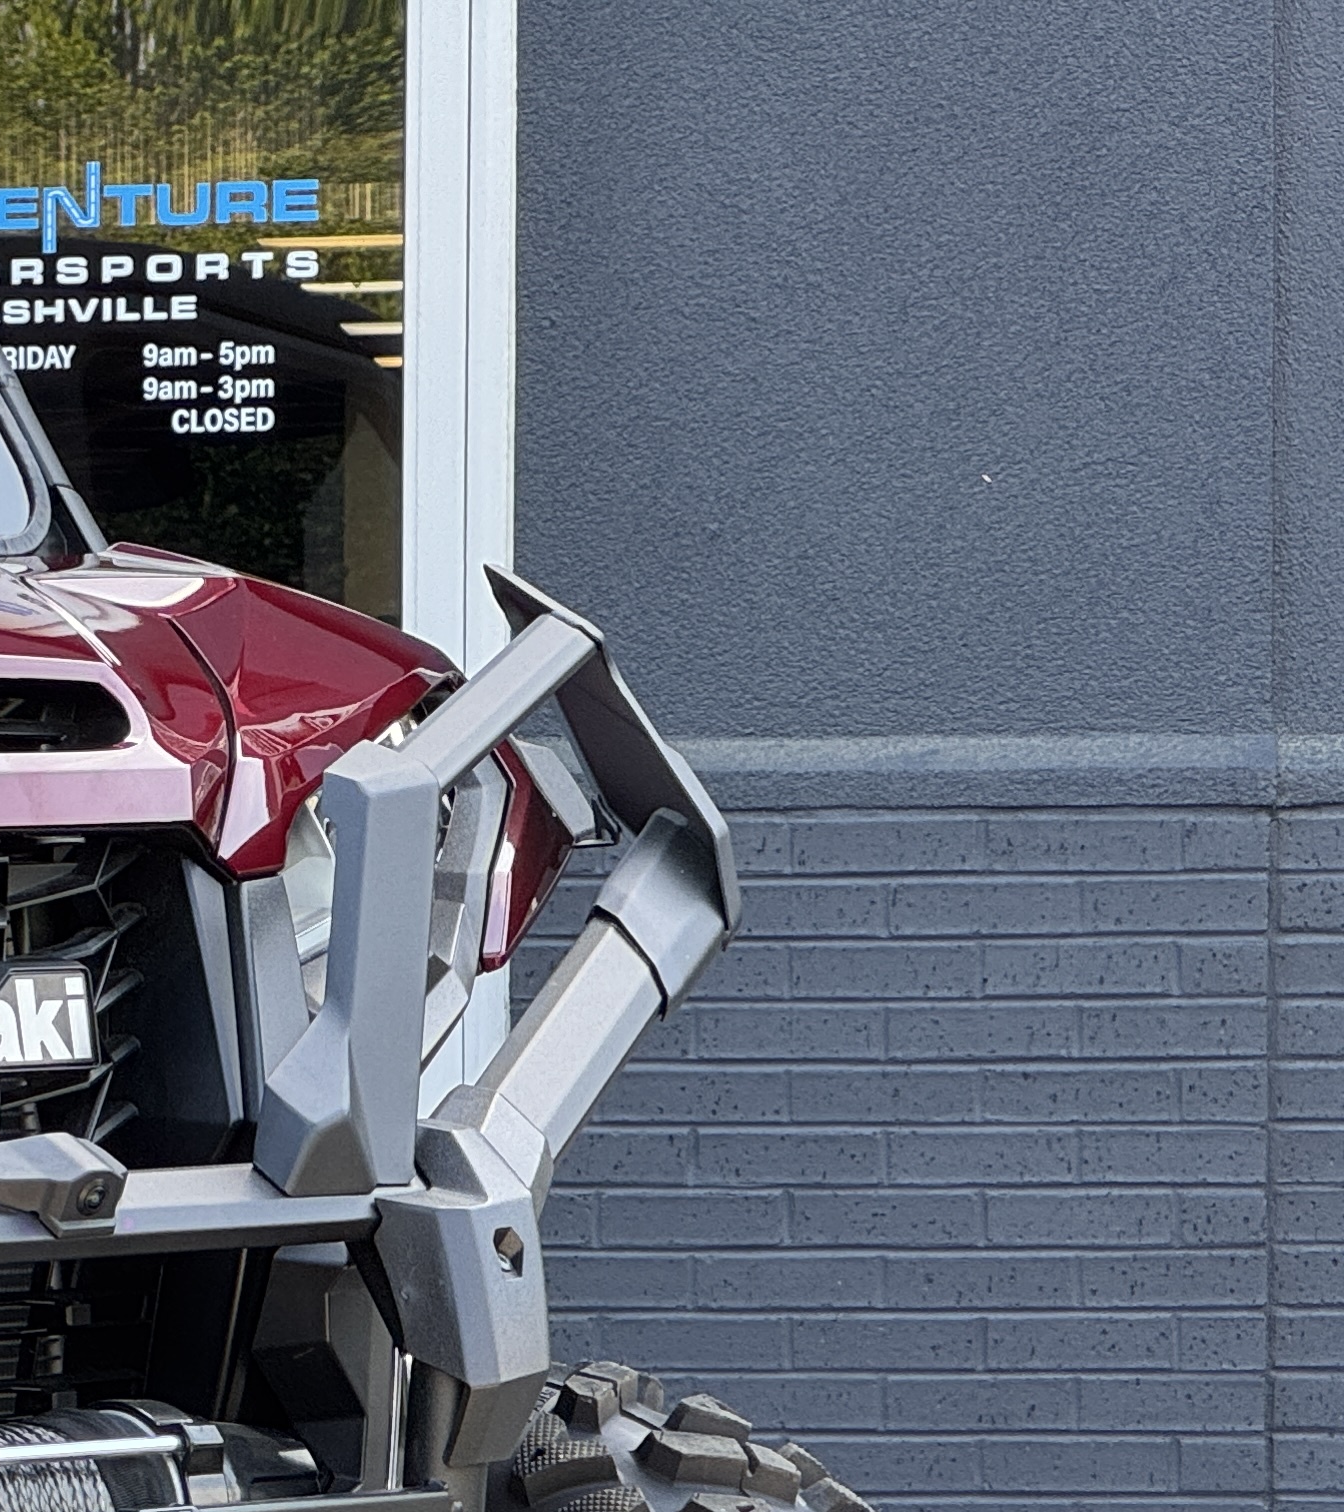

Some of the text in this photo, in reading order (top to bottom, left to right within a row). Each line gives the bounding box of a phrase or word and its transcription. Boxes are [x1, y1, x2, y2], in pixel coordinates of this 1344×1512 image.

[142, 342, 198, 368] 9am
[218, 340, 276, 371] 5pm
[142, 376, 198, 401] 9am
[217, 374, 276, 405] 3pm
[170, 406, 276, 434] CLOSED
